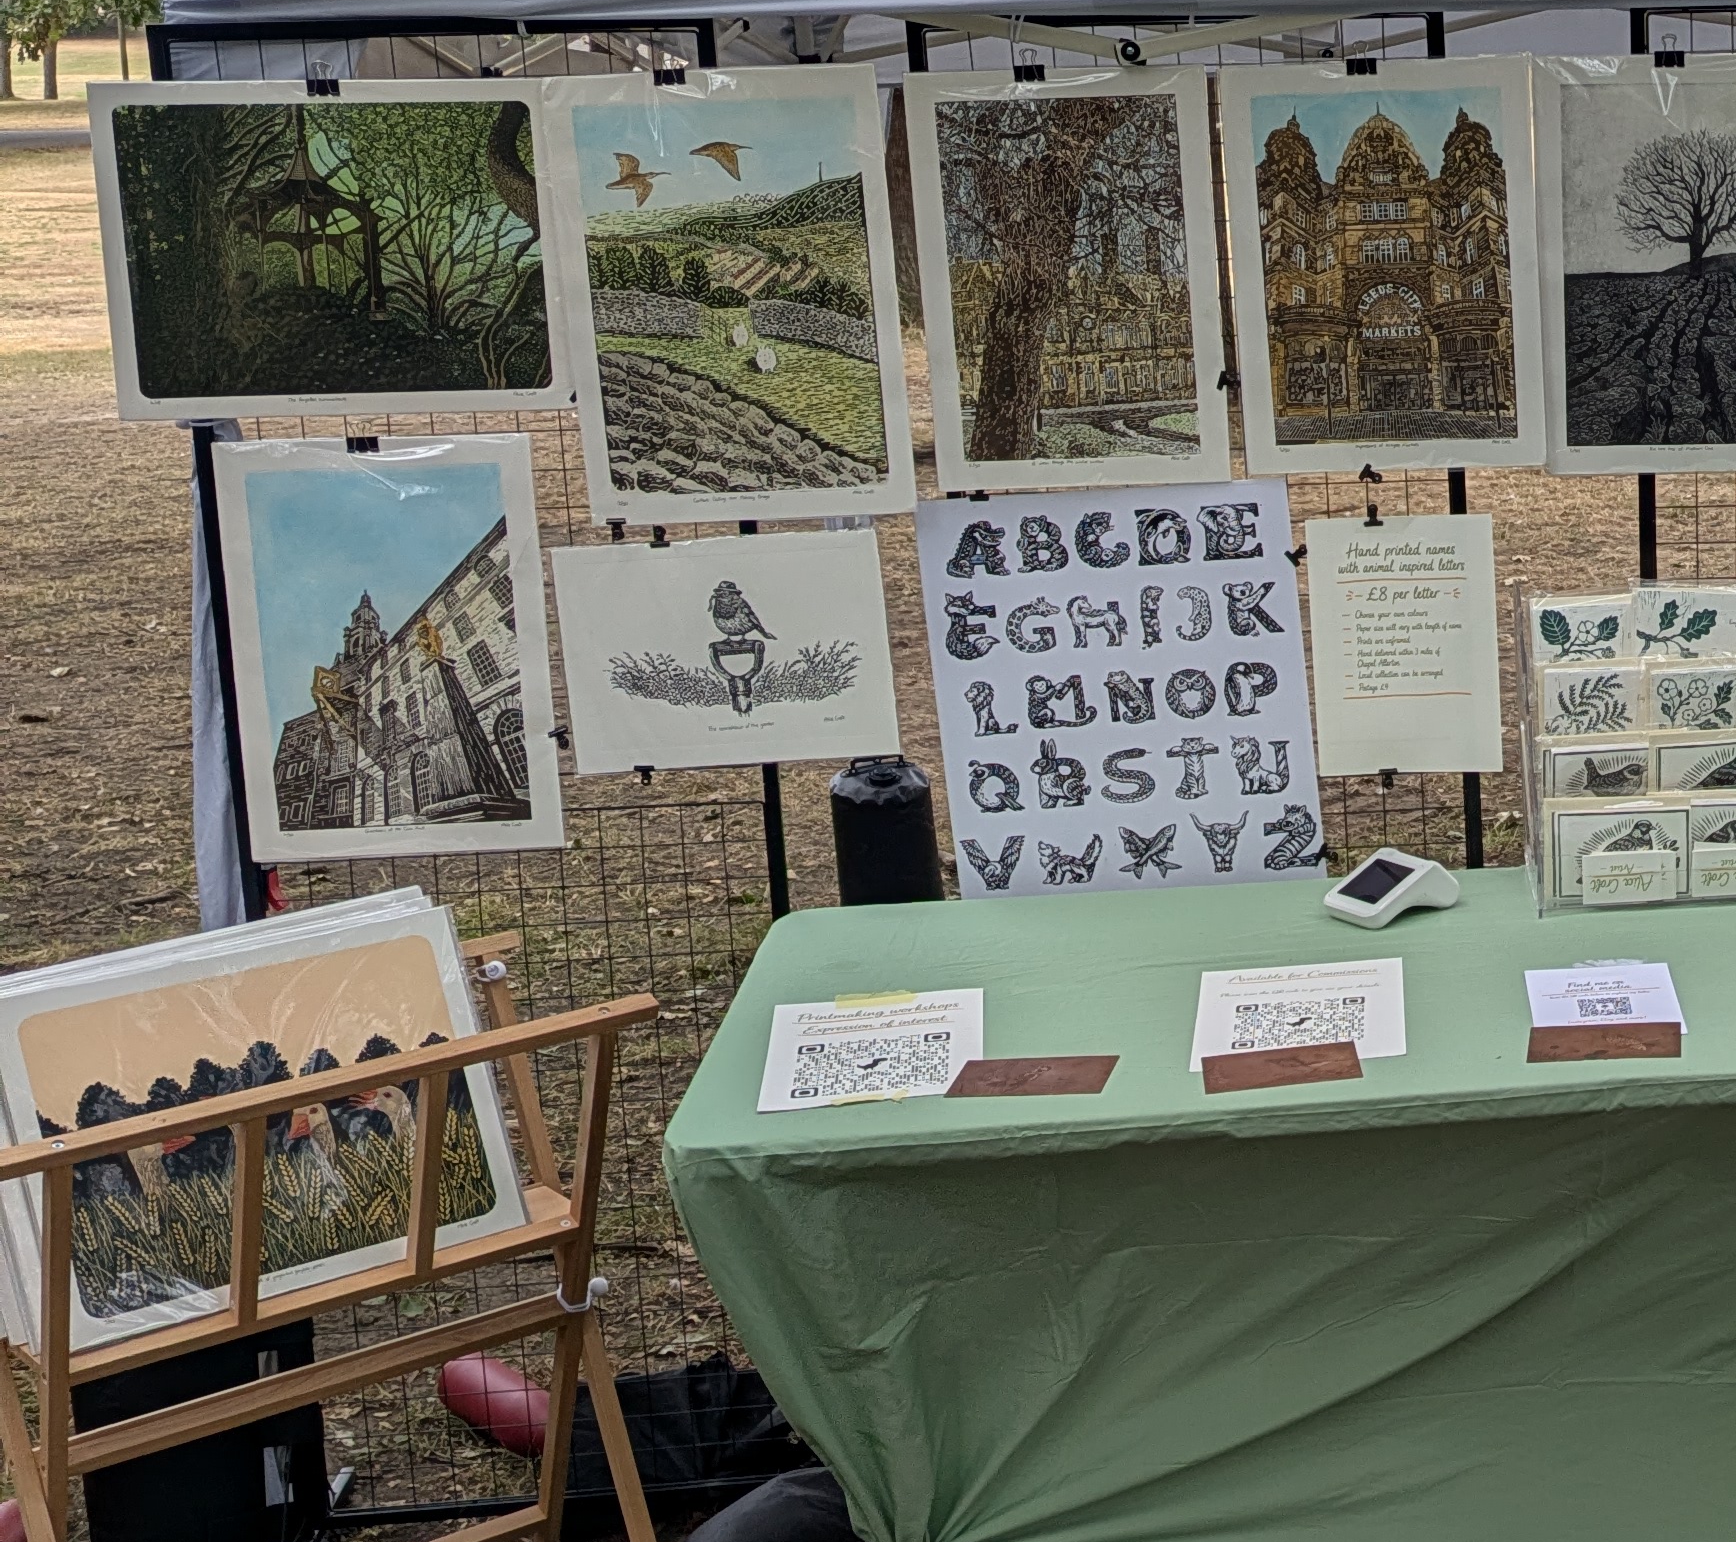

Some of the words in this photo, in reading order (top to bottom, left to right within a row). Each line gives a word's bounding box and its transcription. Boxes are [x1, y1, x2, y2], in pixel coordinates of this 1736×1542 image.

[1358, 284, 1393, 310] LEEDS
[1399, 287, 1422, 309] CITY
[1362, 326, 1421, 337] MARKETS
[1346, 542, 1380, 559] Hand
[1384, 541, 1421, 561] printed
[1426, 545, 1456, 556] names
[1338, 560, 1359, 574] with
[1363, 559, 1395, 573] animal
[1399, 558, 1434, 576] inspired
[1438, 558, 1466, 572] letters
[1366, 586, 1388, 601] £8
[1392, 591, 1410, 604] per
[1413, 586, 1440, 600] letter
[1378, 613, 1392, 621] your
[1407, 609, 1428, 618] colours
[1399, 625, 1410, 634] vary
[1425, 622, 1440, 633] length
[1442, 621, 1448, 631] of
[1357, 636, 1372, 645] Prints
[1385, 636, 1411, 646] unframed
[1375, 647, 1397, 657] delivered
[1399, 647, 1414, 656] within
[1435, 647, 1441, 657] of
[1358, 671, 1373, 679] Local
[1412, 669, 1419, 677] be
[1421, 669, 1444, 679] arranged
[1610, 863, 1635, 874] Artist
[1590, 878, 1619, 894] Croft
[1622, 874, 1654, 892] Alice
[1701, 871, 1730, 887] Croft
[1228, 974, 1284, 984] Available
[1287, 972, 1303, 980] for
[1307, 968, 1378, 978] Commissions
[1565, 985, 1595, 993] social
[1567, 981, 1591, 989] Find
[798, 1010, 885, 1023] Printmaking
[890, 1002, 959, 1015] workshops
[803, 1023, 875, 1036] Expression
[879, 1020, 894, 1029] of
[898, 1014, 947, 1026] interest
